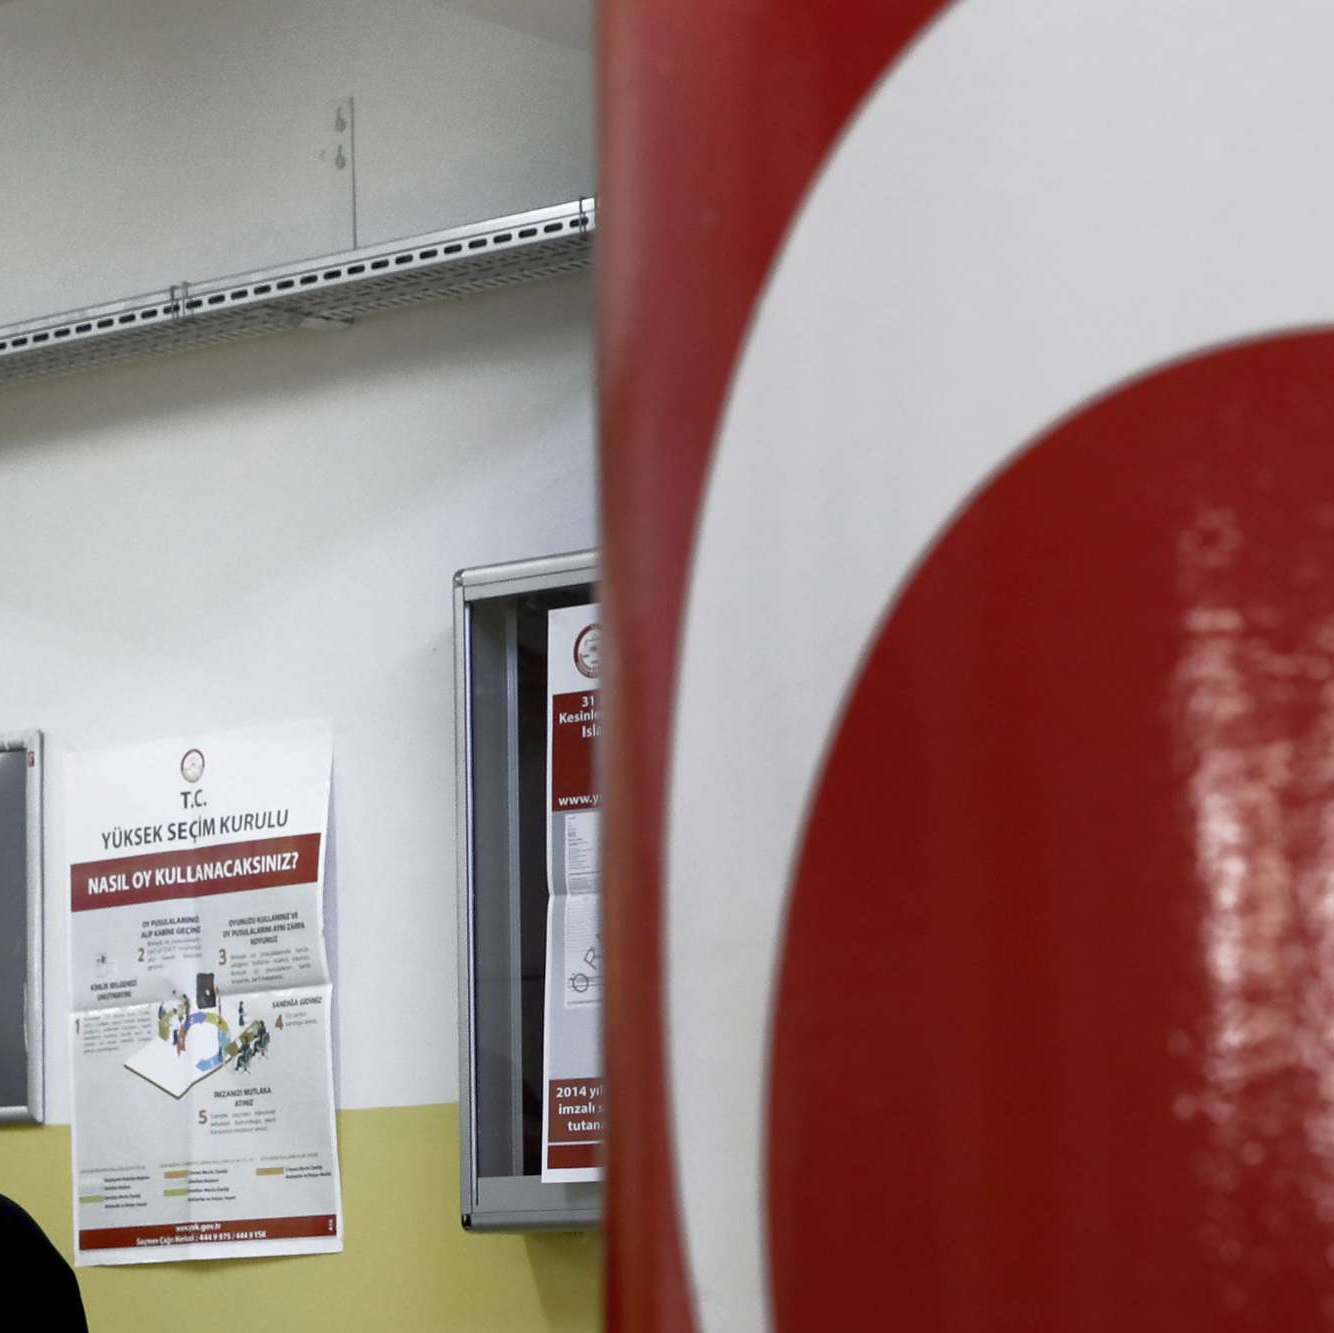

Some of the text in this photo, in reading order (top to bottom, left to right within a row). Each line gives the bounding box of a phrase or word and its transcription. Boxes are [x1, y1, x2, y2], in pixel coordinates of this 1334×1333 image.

[581, 696, 595, 708] 31
[180, 789, 207, 809] T.C.
[101, 809, 290, 850] YÜKSEK SEÇİM KURULU
[88, 852, 299, 895] NASIL OY KULLANACAKSINIZ?
[138, 947, 145, 962] 2
[218, 948, 227, 966] 3
[75, 1018, 80, 1035] 1
[275, 1013, 284, 1031] 4
[556, 1086, 587, 1098] 2014
[558, 1102, 595, 1115] imzalı
[198, 1109, 208, 1125] 5
[568, 1120, 603, 1131] tutan
